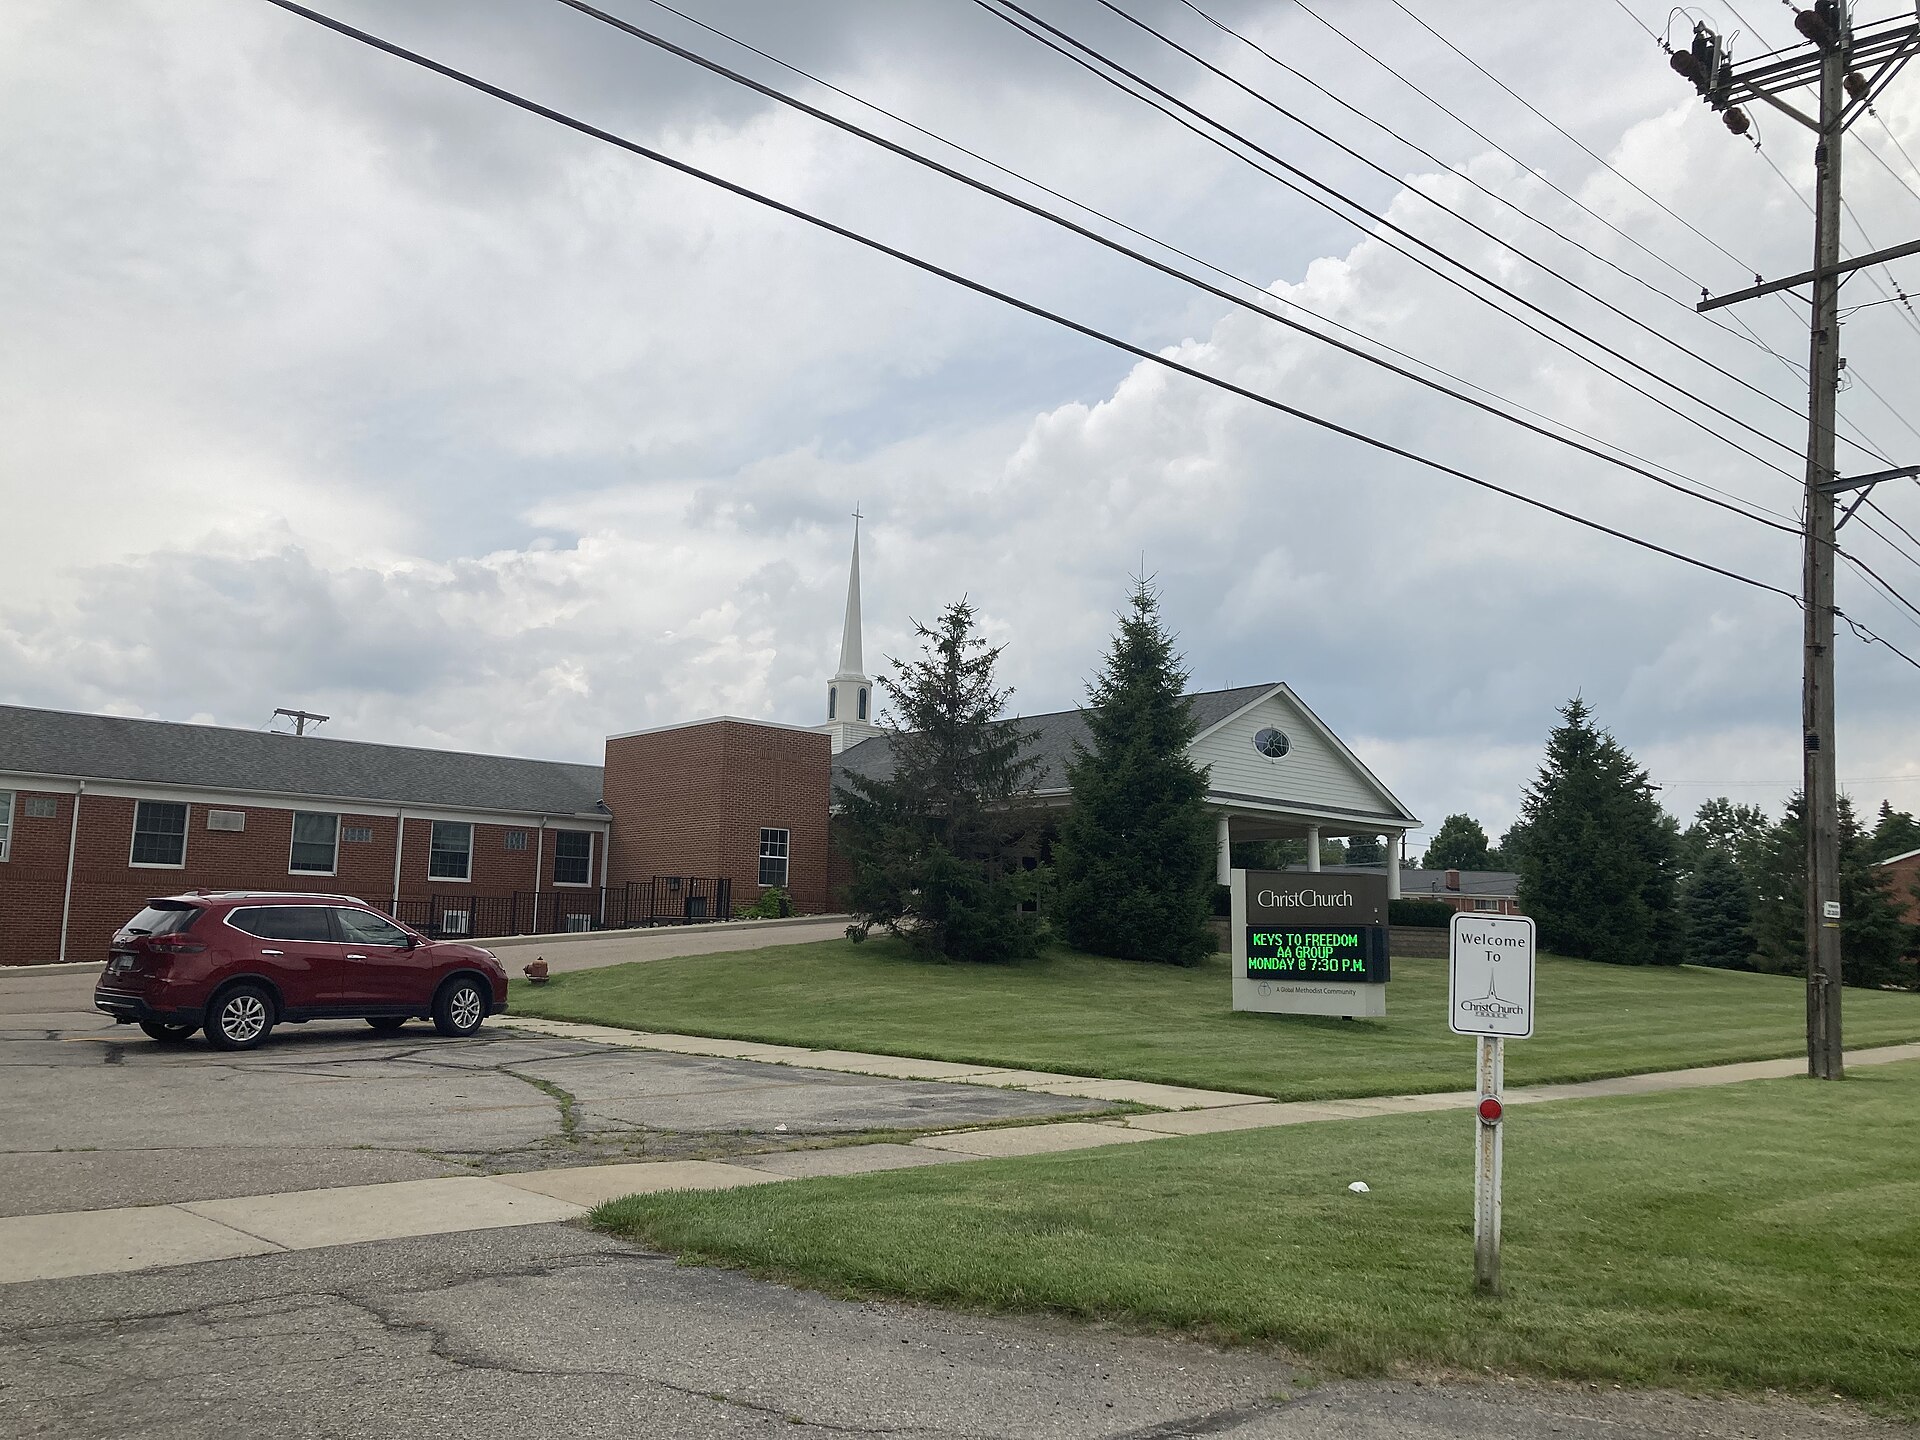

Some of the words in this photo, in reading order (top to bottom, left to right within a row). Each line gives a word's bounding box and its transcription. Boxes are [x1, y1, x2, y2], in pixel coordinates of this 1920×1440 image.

[1257, 889, 1353, 908] ChristChurch
[1253, 933, 1282, 946] KEYS
[1286, 933, 1302, 946] TO
[1305, 933, 1358, 947] FREEDOM
[1461, 932, 1526, 948] Welcome
[1277, 946, 1292, 958] AA
[1295, 946, 1333, 959] GROUP
[1485, 950, 1501, 962] To
[1248, 957, 1294, 970] MONDAY
[1298, 958, 1306, 971] @
[1309, 958, 1338, 971] 7:30
[1342, 958, 1366, 972] P.M.
[1295, 986, 1323, 994] Methodist
[1323, 987, 1357, 996] Community
[1460, 1000, 1524, 1015] ChristChurch
